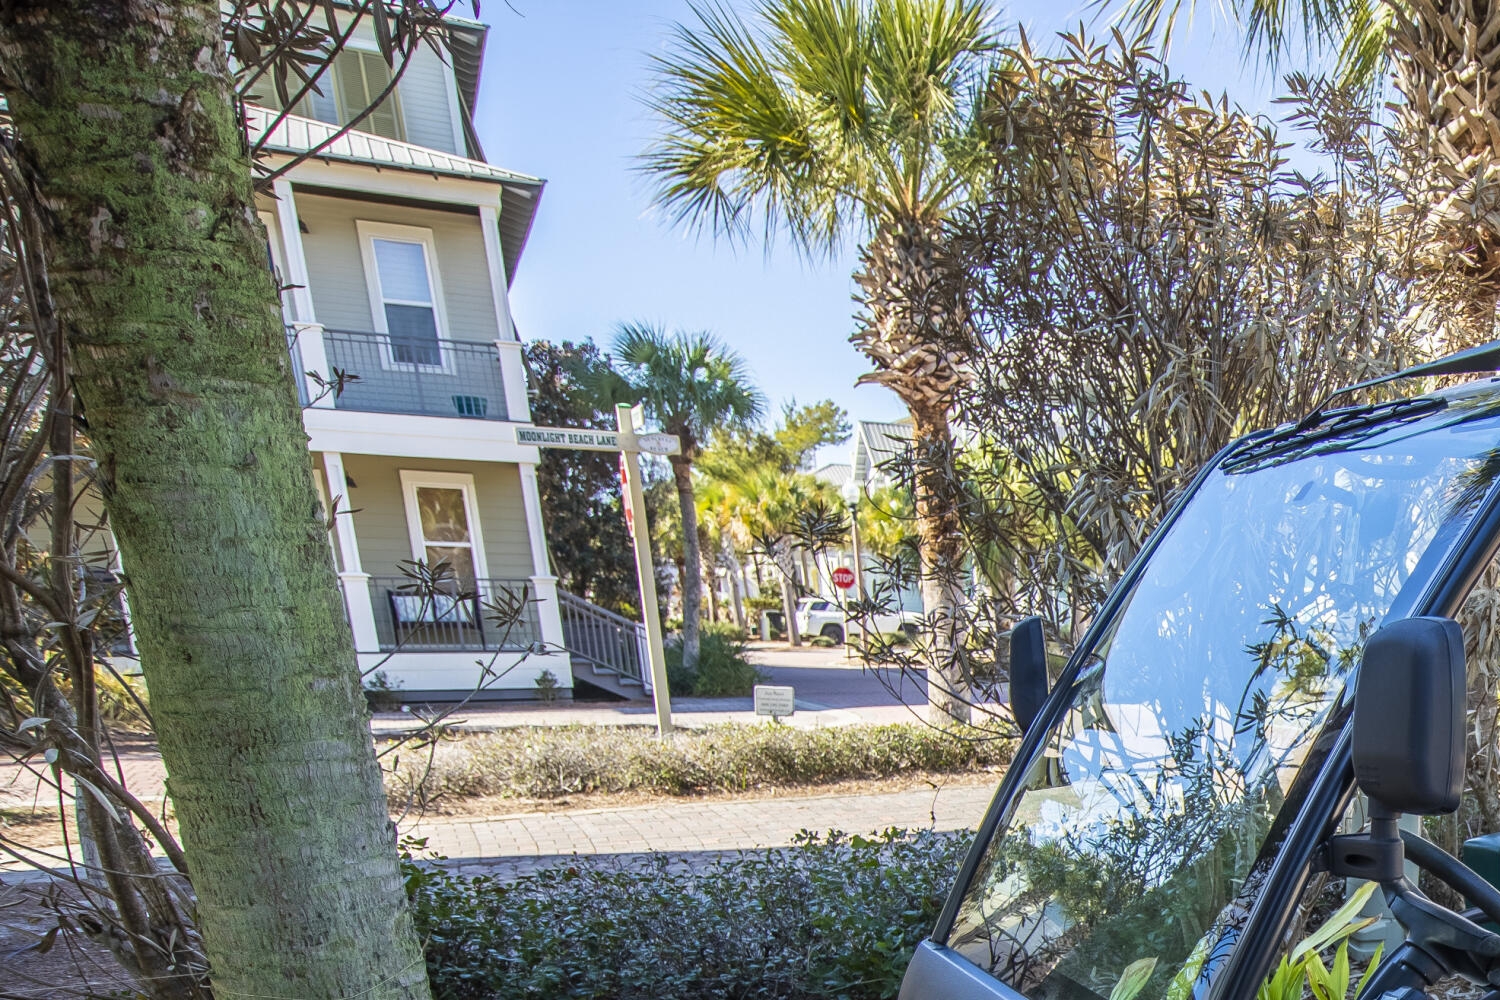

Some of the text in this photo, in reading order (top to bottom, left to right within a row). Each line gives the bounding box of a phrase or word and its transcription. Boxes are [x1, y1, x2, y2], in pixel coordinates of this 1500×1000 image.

[519, 431, 617, 446] MOONLIGHT BEACH LANE
[832, 573, 854, 583] STOP
